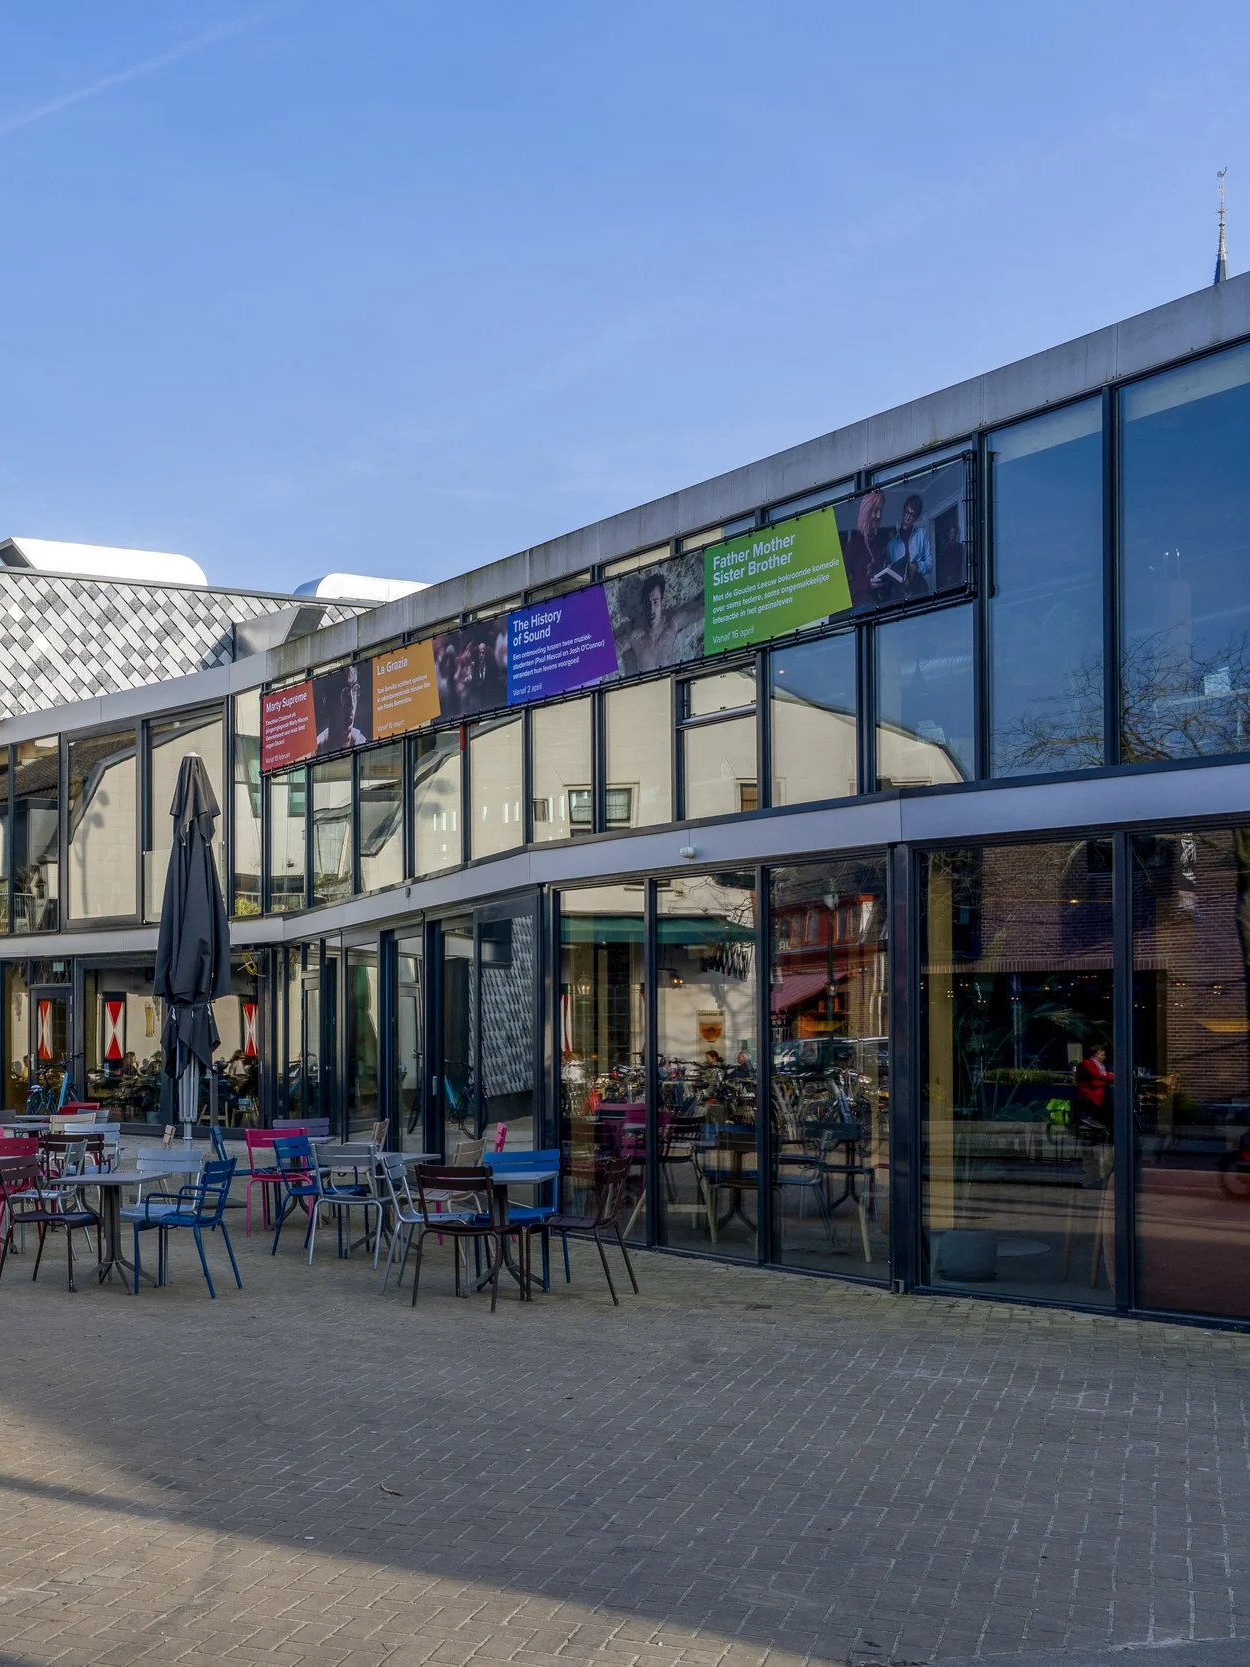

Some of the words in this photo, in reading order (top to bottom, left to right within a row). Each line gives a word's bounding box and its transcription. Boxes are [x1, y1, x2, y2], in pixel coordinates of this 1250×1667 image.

[713, 549, 750, 570] Father
[753, 534, 795, 557] Mother
[712, 594, 724, 603] Met
[725, 591, 732, 599] de
[733, 584, 757, 596] Gouden
[757, 579, 777, 590] Leeuw
[778, 568, 811, 583] bekroonde
[812, 558, 839, 572] komedie
[713, 567, 745, 586] Sister
[748, 552, 793, 576] Brother
[712, 605, 726, 613] over
[726, 601, 742, 610] soms
[743, 594, 763, 606] tedere,
[764, 590, 780, 599] soms
[781, 574, 830, 593] ongemakkelijke
[513, 621, 529, 632] The
[531, 610, 562, 628] History
[712, 612, 739, 625] interactie
[747, 606, 757, 615] het
[757, 597, 793, 613] gezinsleven
[513, 633, 522, 646] of
[523, 625, 551, 643] Sound
[513, 653, 521, 661] Een
[522, 646, 546, 658] ontmoeting
[547, 642, 561, 651] tussen
[562, 638, 573, 647] twee
[574, 633, 592, 643] muziek-
[712, 632, 731, 644] Vanaf
[732, 630, 739, 639] 16
[740, 626, 754, 637] april
[377, 665, 385, 676] La
[386, 656, 408, 672] Grazia
[512, 660, 534, 670] studenten
[534, 656, 546, 665] (Paul
[546, 651, 562, 661] Mescal
[569, 646, 580, 655] Josh
[581, 639, 605, 651] O'Connor)
[512, 668, 533, 680] verandert
[543, 662, 557, 672] levens
[558, 656, 580, 668] voorgoed
[513, 686, 526, 696] Vanaf
[527, 685, 531, 693] 2
[531, 682, 542, 691] april
[266, 701, 281, 713] Marty
[282, 692, 307, 708] Supreme
